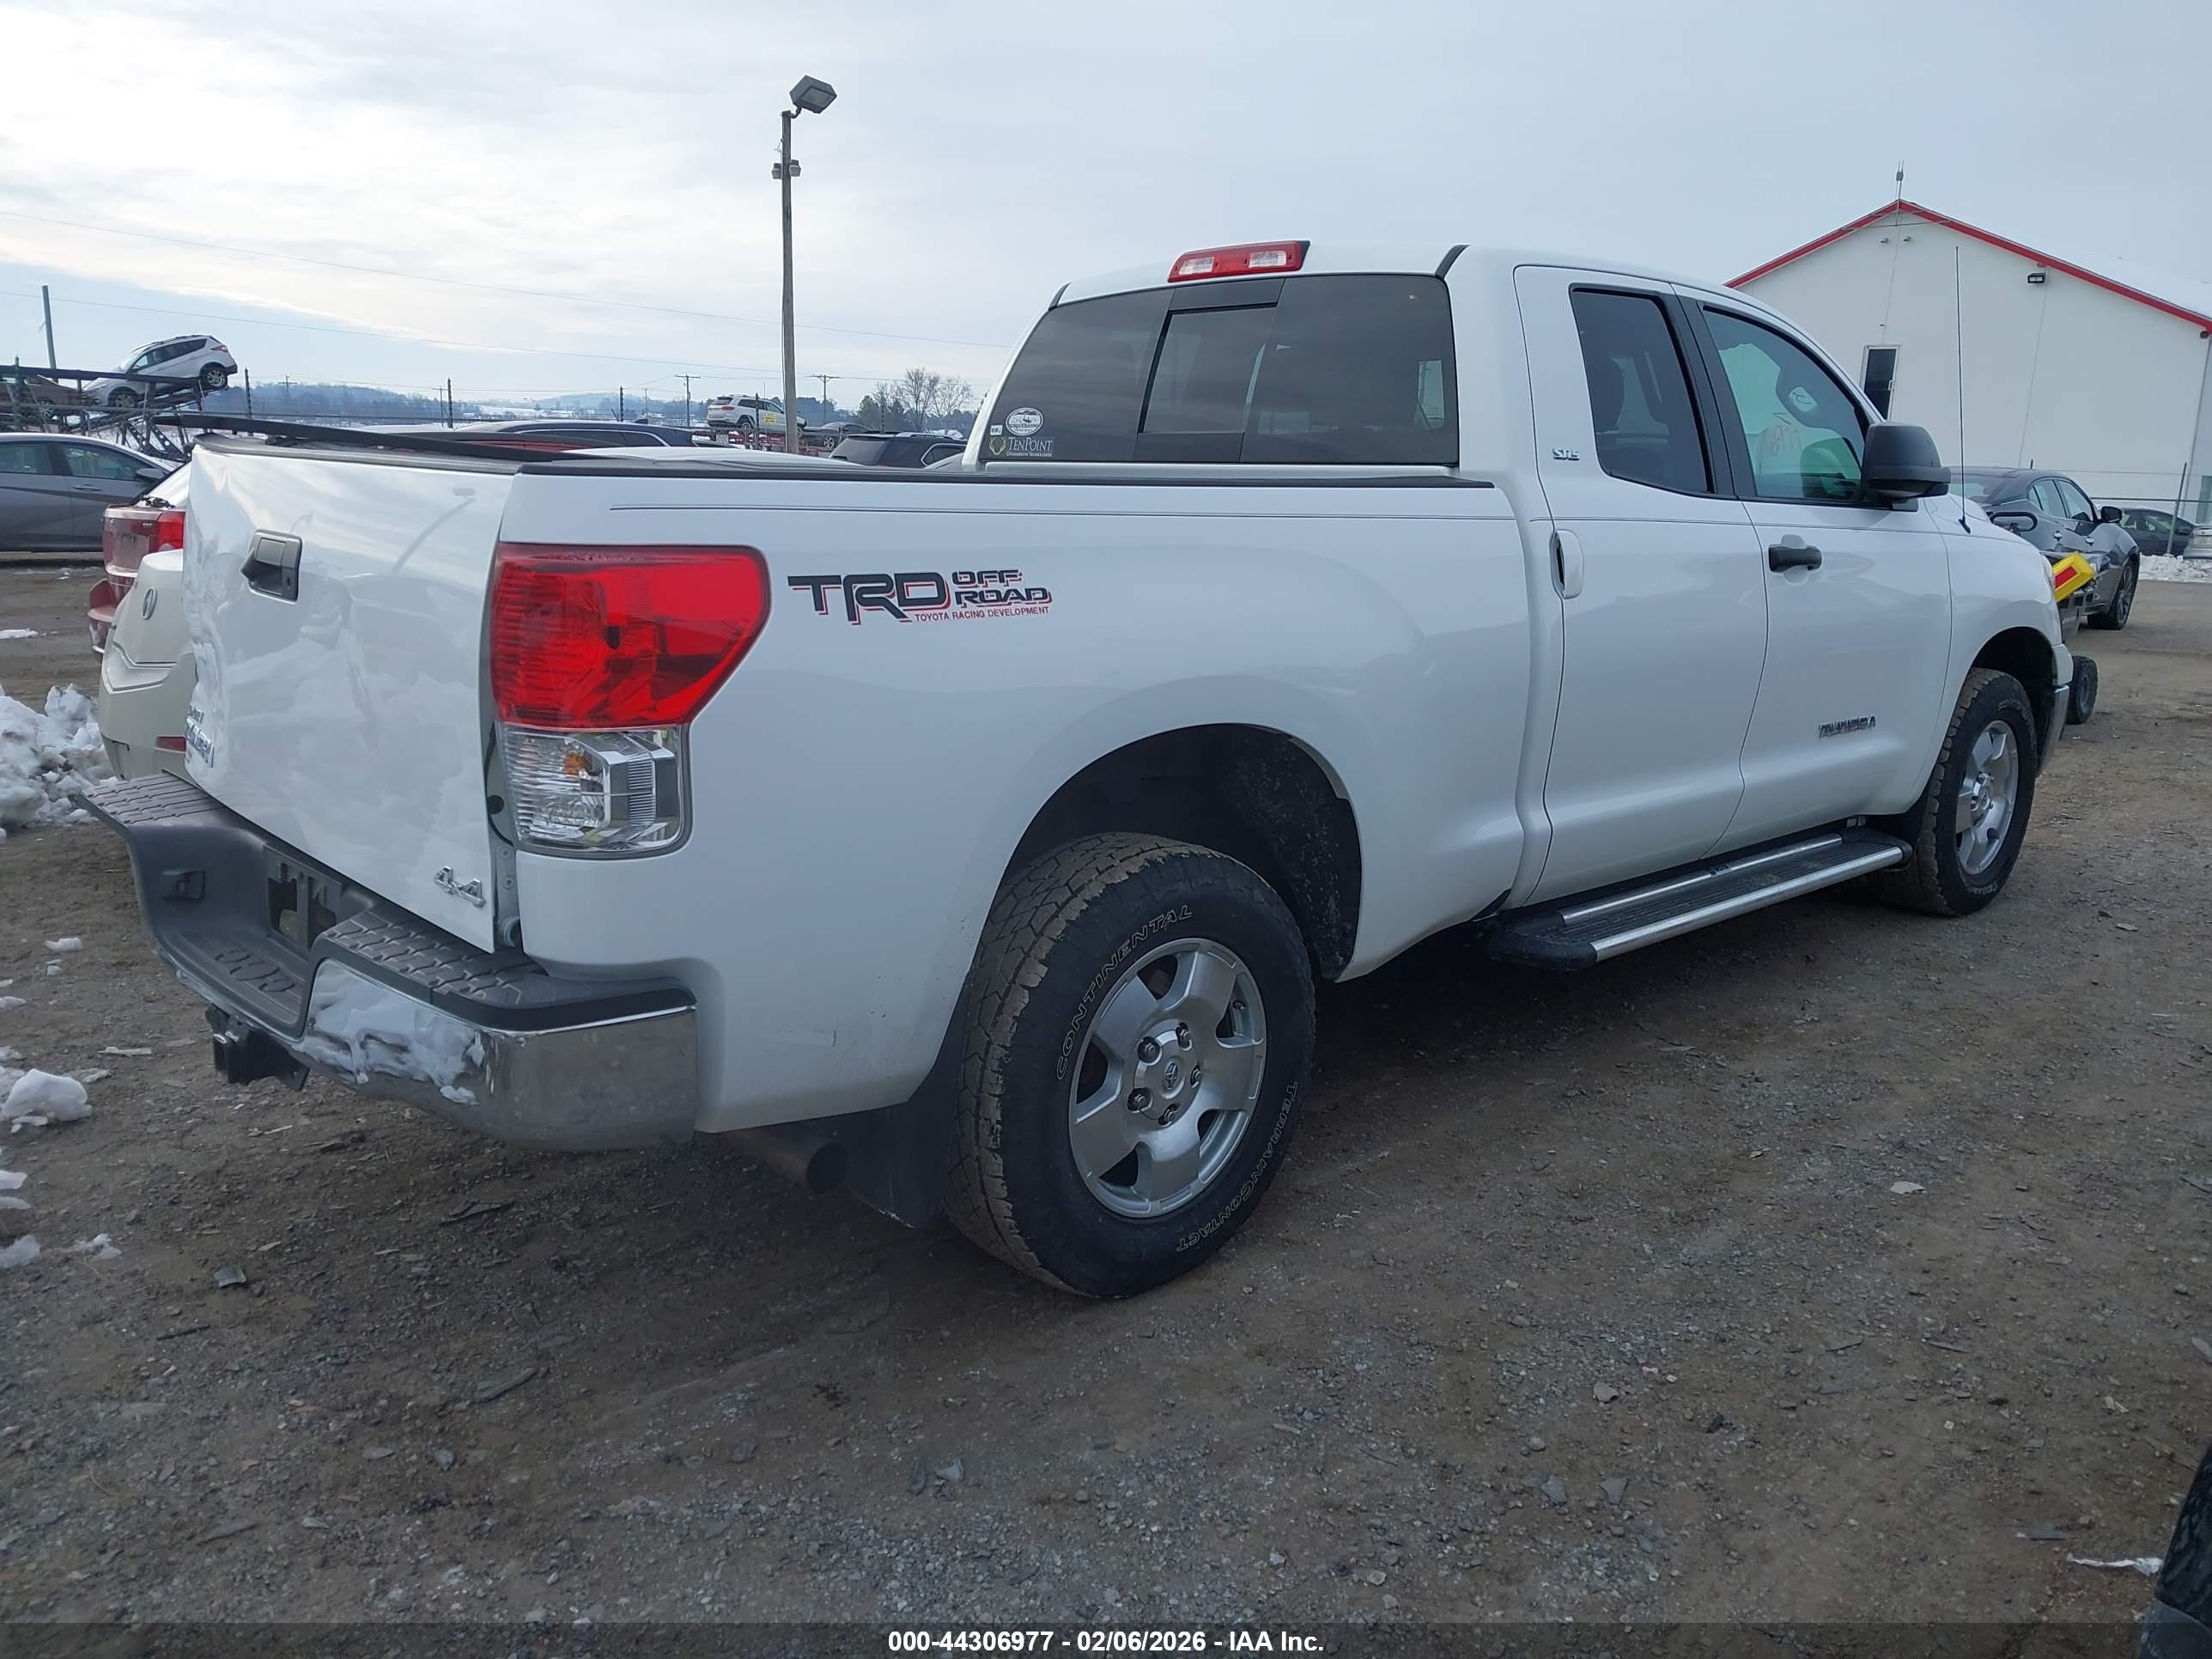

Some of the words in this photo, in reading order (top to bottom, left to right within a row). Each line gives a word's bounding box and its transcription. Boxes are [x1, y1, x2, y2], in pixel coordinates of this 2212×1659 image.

[951, 569, 1024, 587] OFF
[787, 572, 951, 626] TRD
[954, 587, 1053, 608] ROAD
[915, 611, 951, 623] TOYOTA
[951, 609, 986, 621] RACING
[987, 605, 1050, 618] DEVELOPMENT
[1056, 904, 1193, 1080] CONTINENTAL
